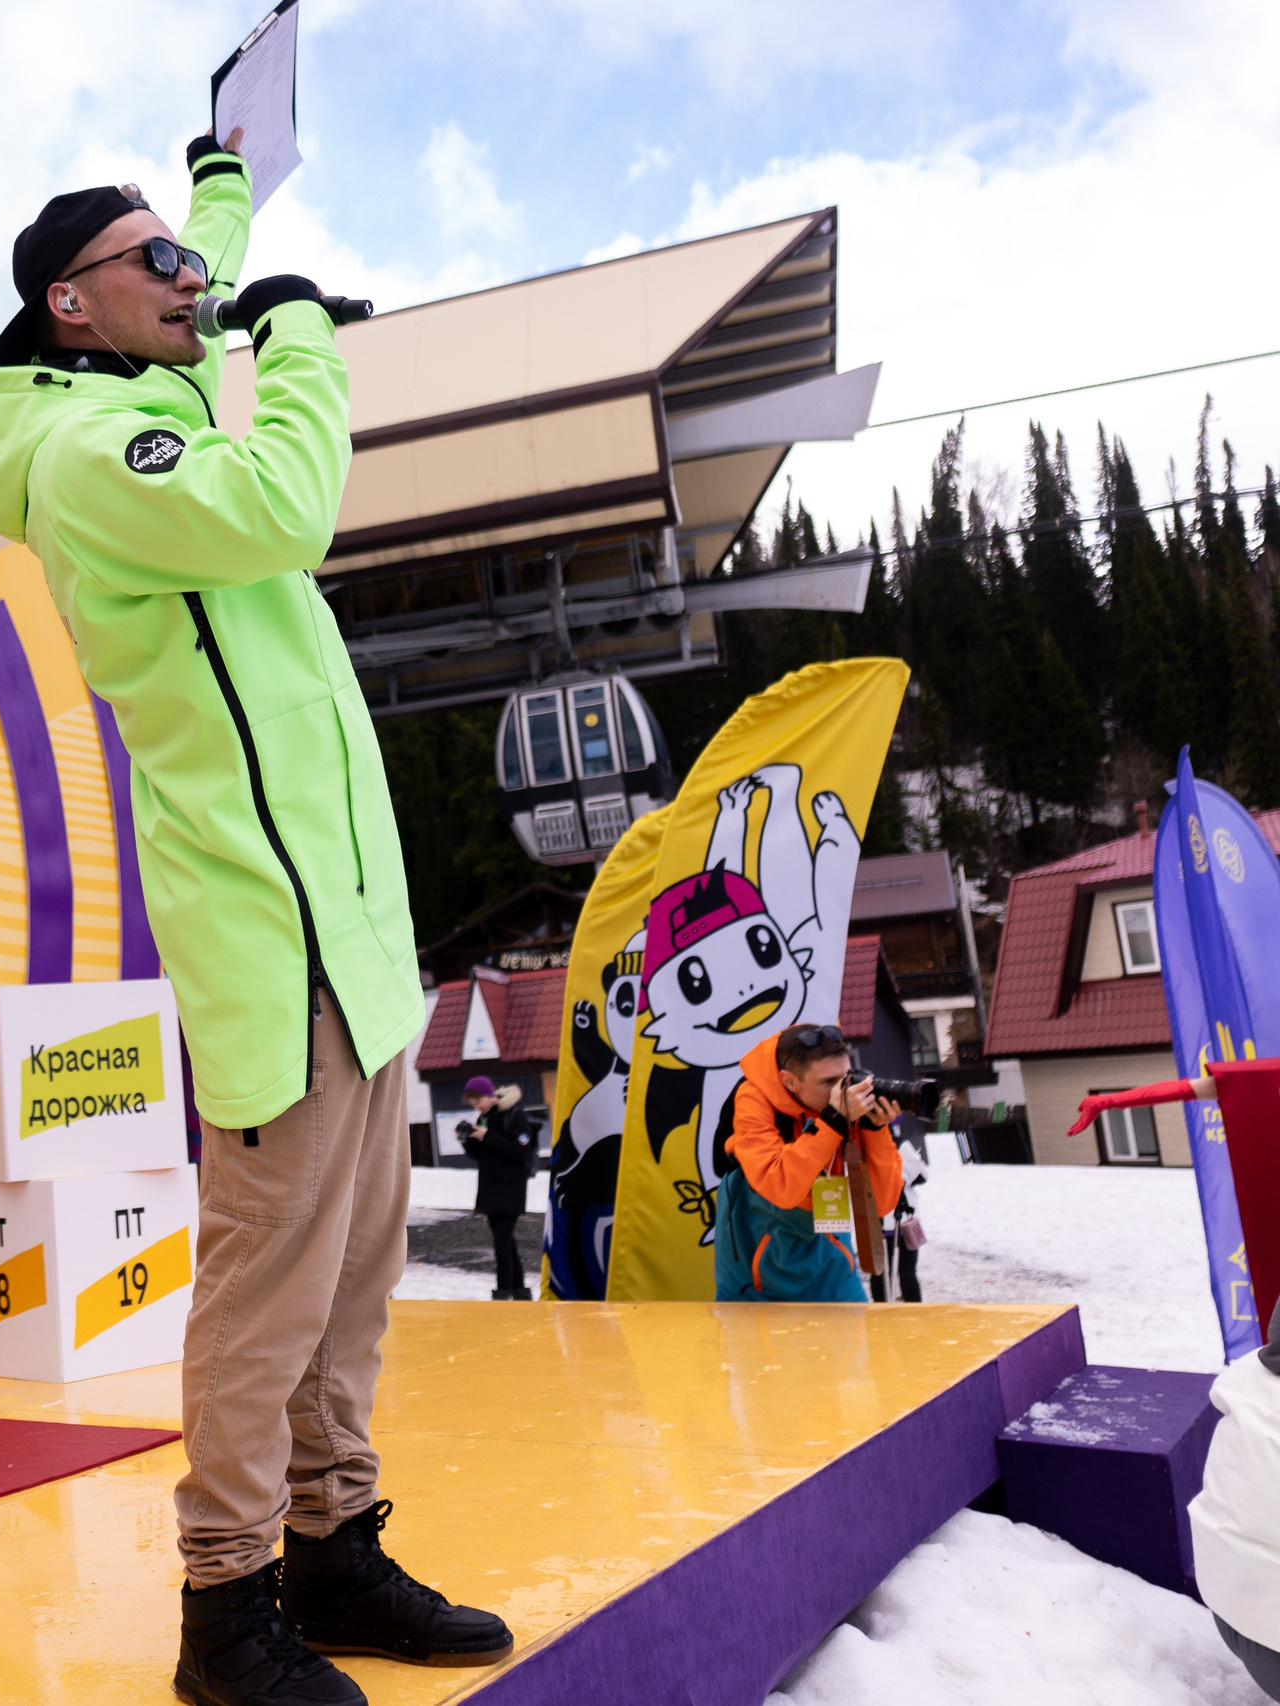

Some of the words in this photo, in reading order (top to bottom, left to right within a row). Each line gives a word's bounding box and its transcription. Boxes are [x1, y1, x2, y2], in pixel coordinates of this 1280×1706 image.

[133, 438, 178, 470] MOUNTAIN
[162, 444, 185, 461] MAN
[30, 1044, 140, 1082] Красная
[28, 1091, 147, 1128] дорожка
[114, 1206, 146, 1240] ПТ
[117, 1262, 149, 1308] 19
